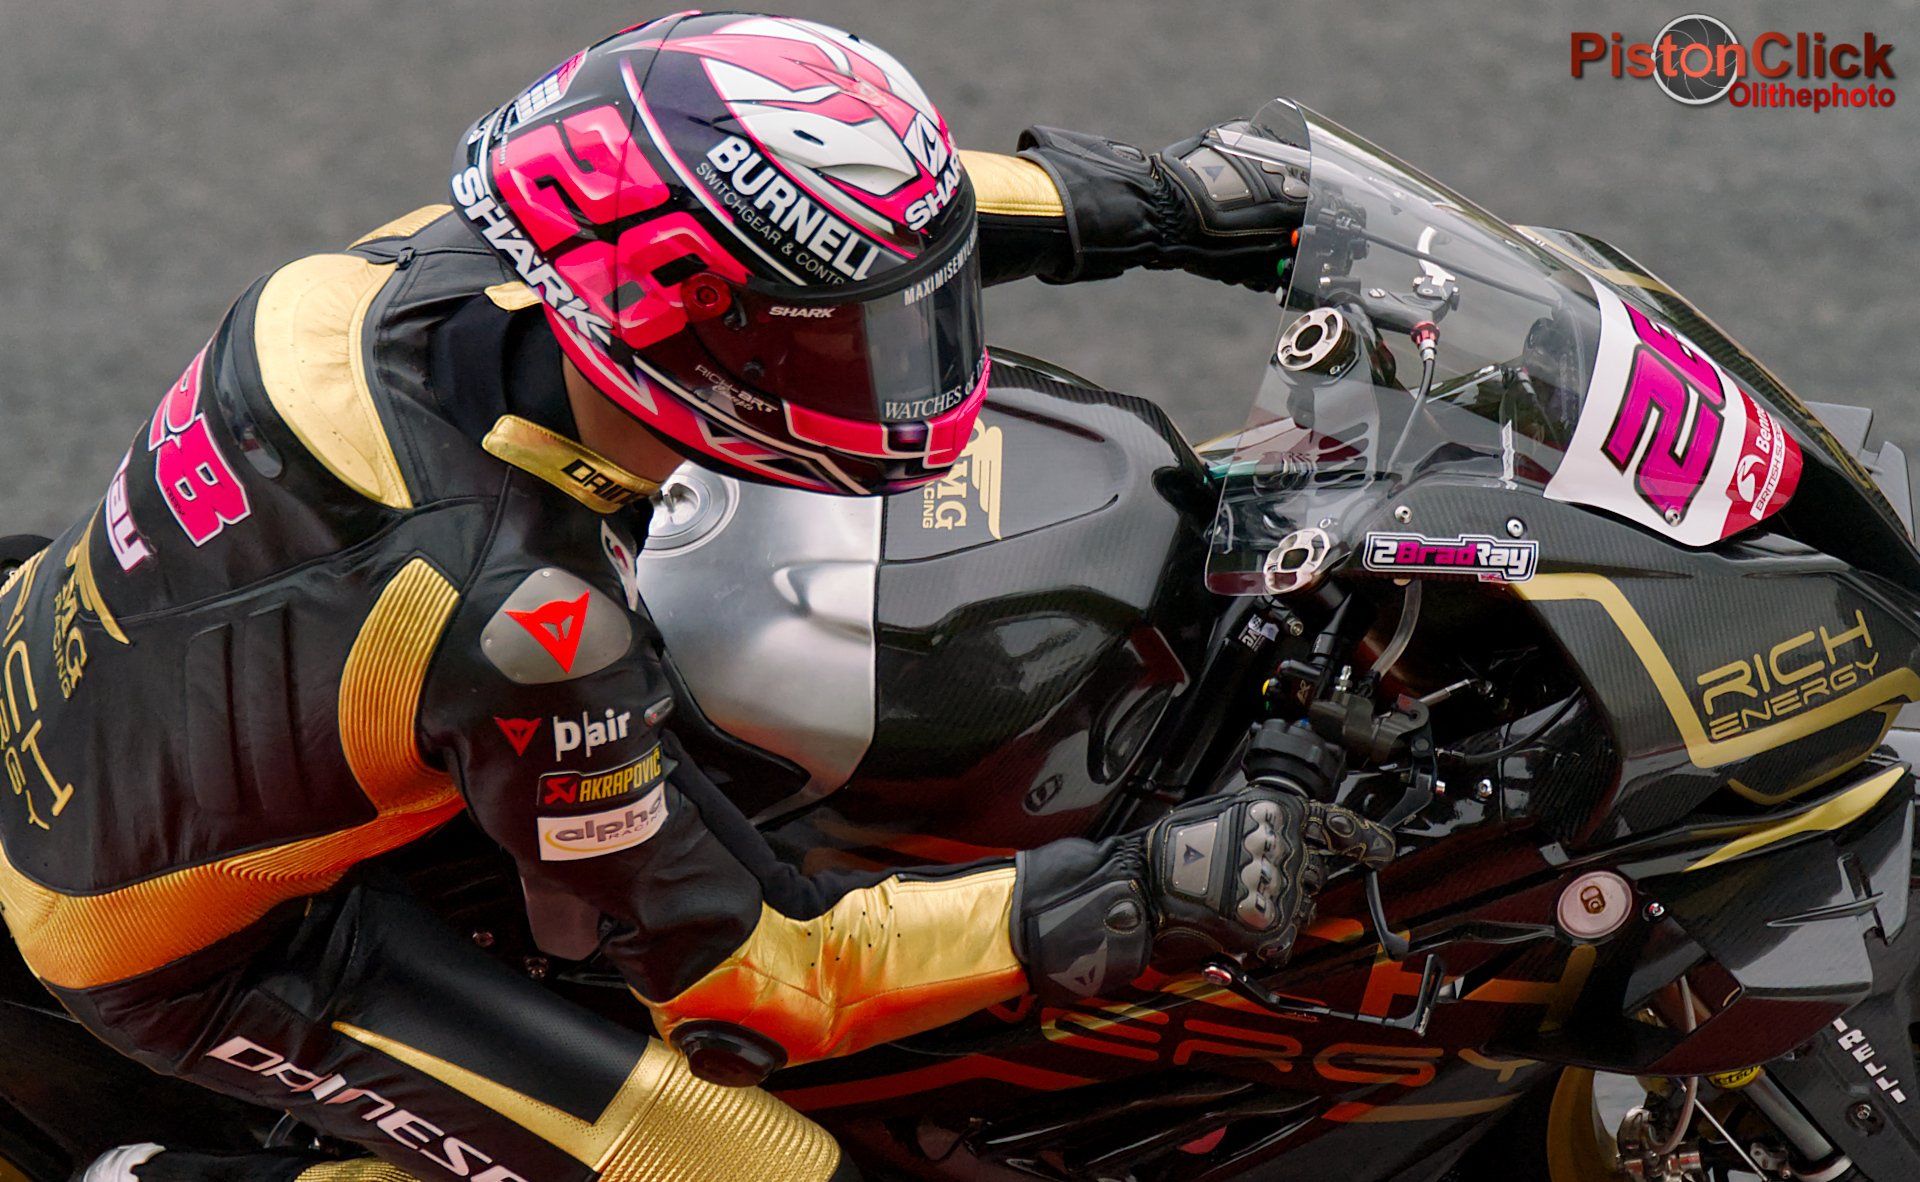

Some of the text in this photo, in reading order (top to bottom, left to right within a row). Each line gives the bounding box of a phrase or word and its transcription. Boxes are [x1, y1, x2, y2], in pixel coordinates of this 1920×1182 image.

[696, 162, 782, 245] SWITCHGEAR
[781, 242, 794, 257] &
[706, 135, 880, 281] BURNELL
[905, 131, 962, 231] SHAR
[451, 166, 613, 346] SHARK
[769, 306, 836, 318] SHARK
[885, 385, 962, 419] WATCHES
[922, 482, 935, 529] CING
[935, 460, 968, 530] MG
[1697, 609, 1873, 716] RICH
[1709, 652, 1879, 740] ENERGY
[1832, 1017, 1907, 1104] IRELLI
